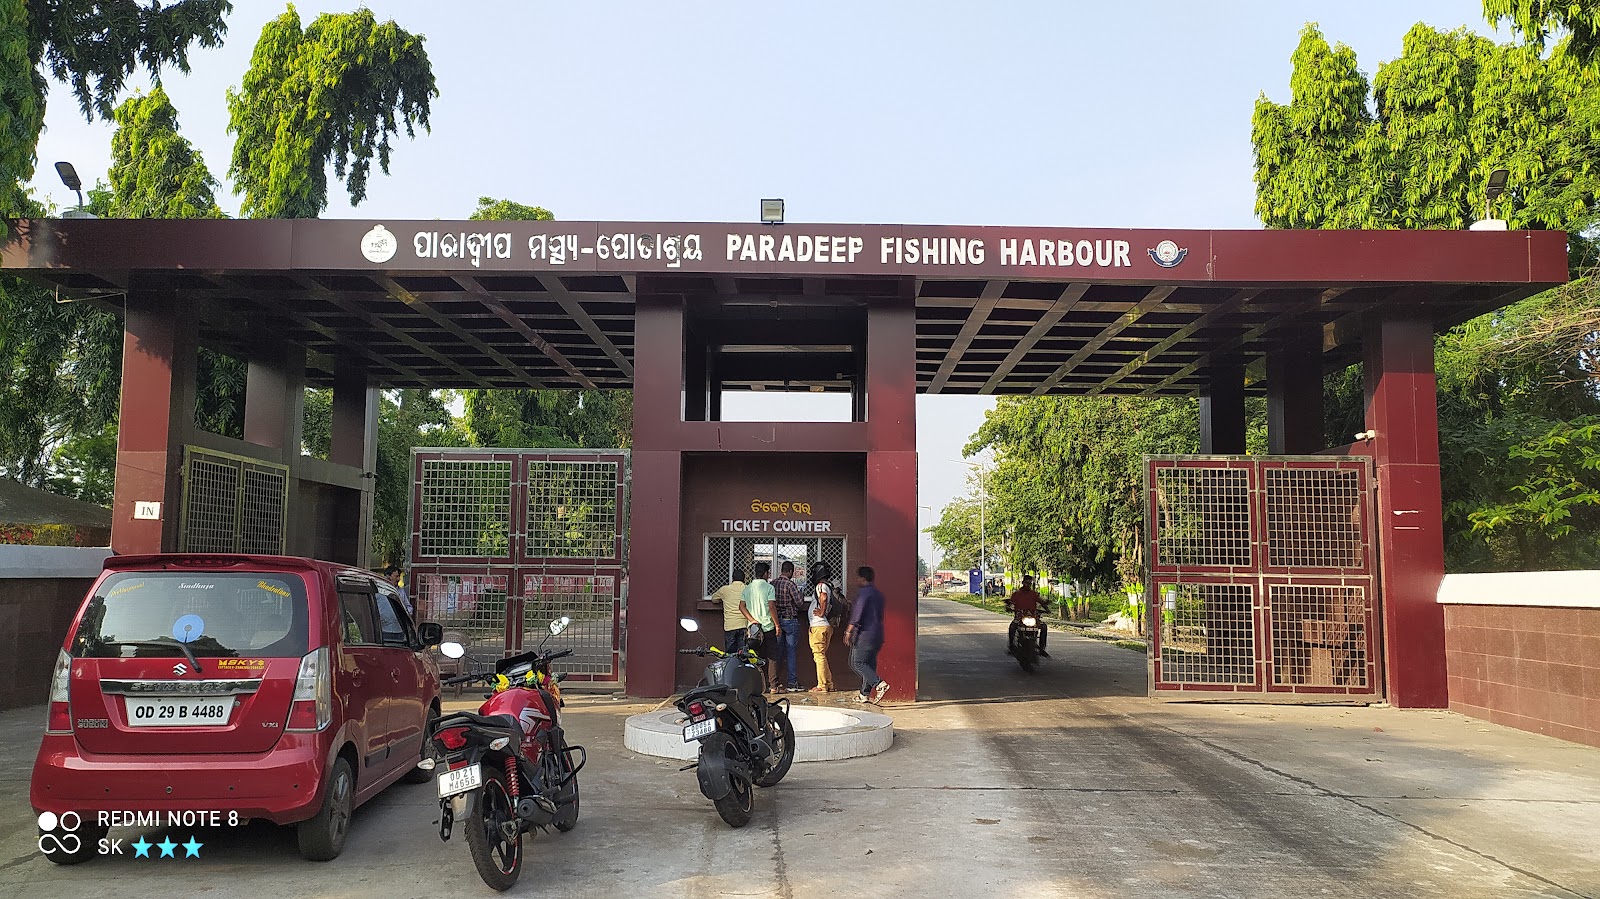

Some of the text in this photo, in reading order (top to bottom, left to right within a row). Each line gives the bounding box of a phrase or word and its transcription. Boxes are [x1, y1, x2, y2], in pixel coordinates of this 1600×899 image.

[726, 234, 1131, 268] PARADEEP FISHING HARBOUR
[141, 506, 154, 516] IN
[721, 519, 831, 532] TICKET COUNTER
[135, 705, 224, 719] OD 29 B 4488
[462, 767, 474, 778] 21
